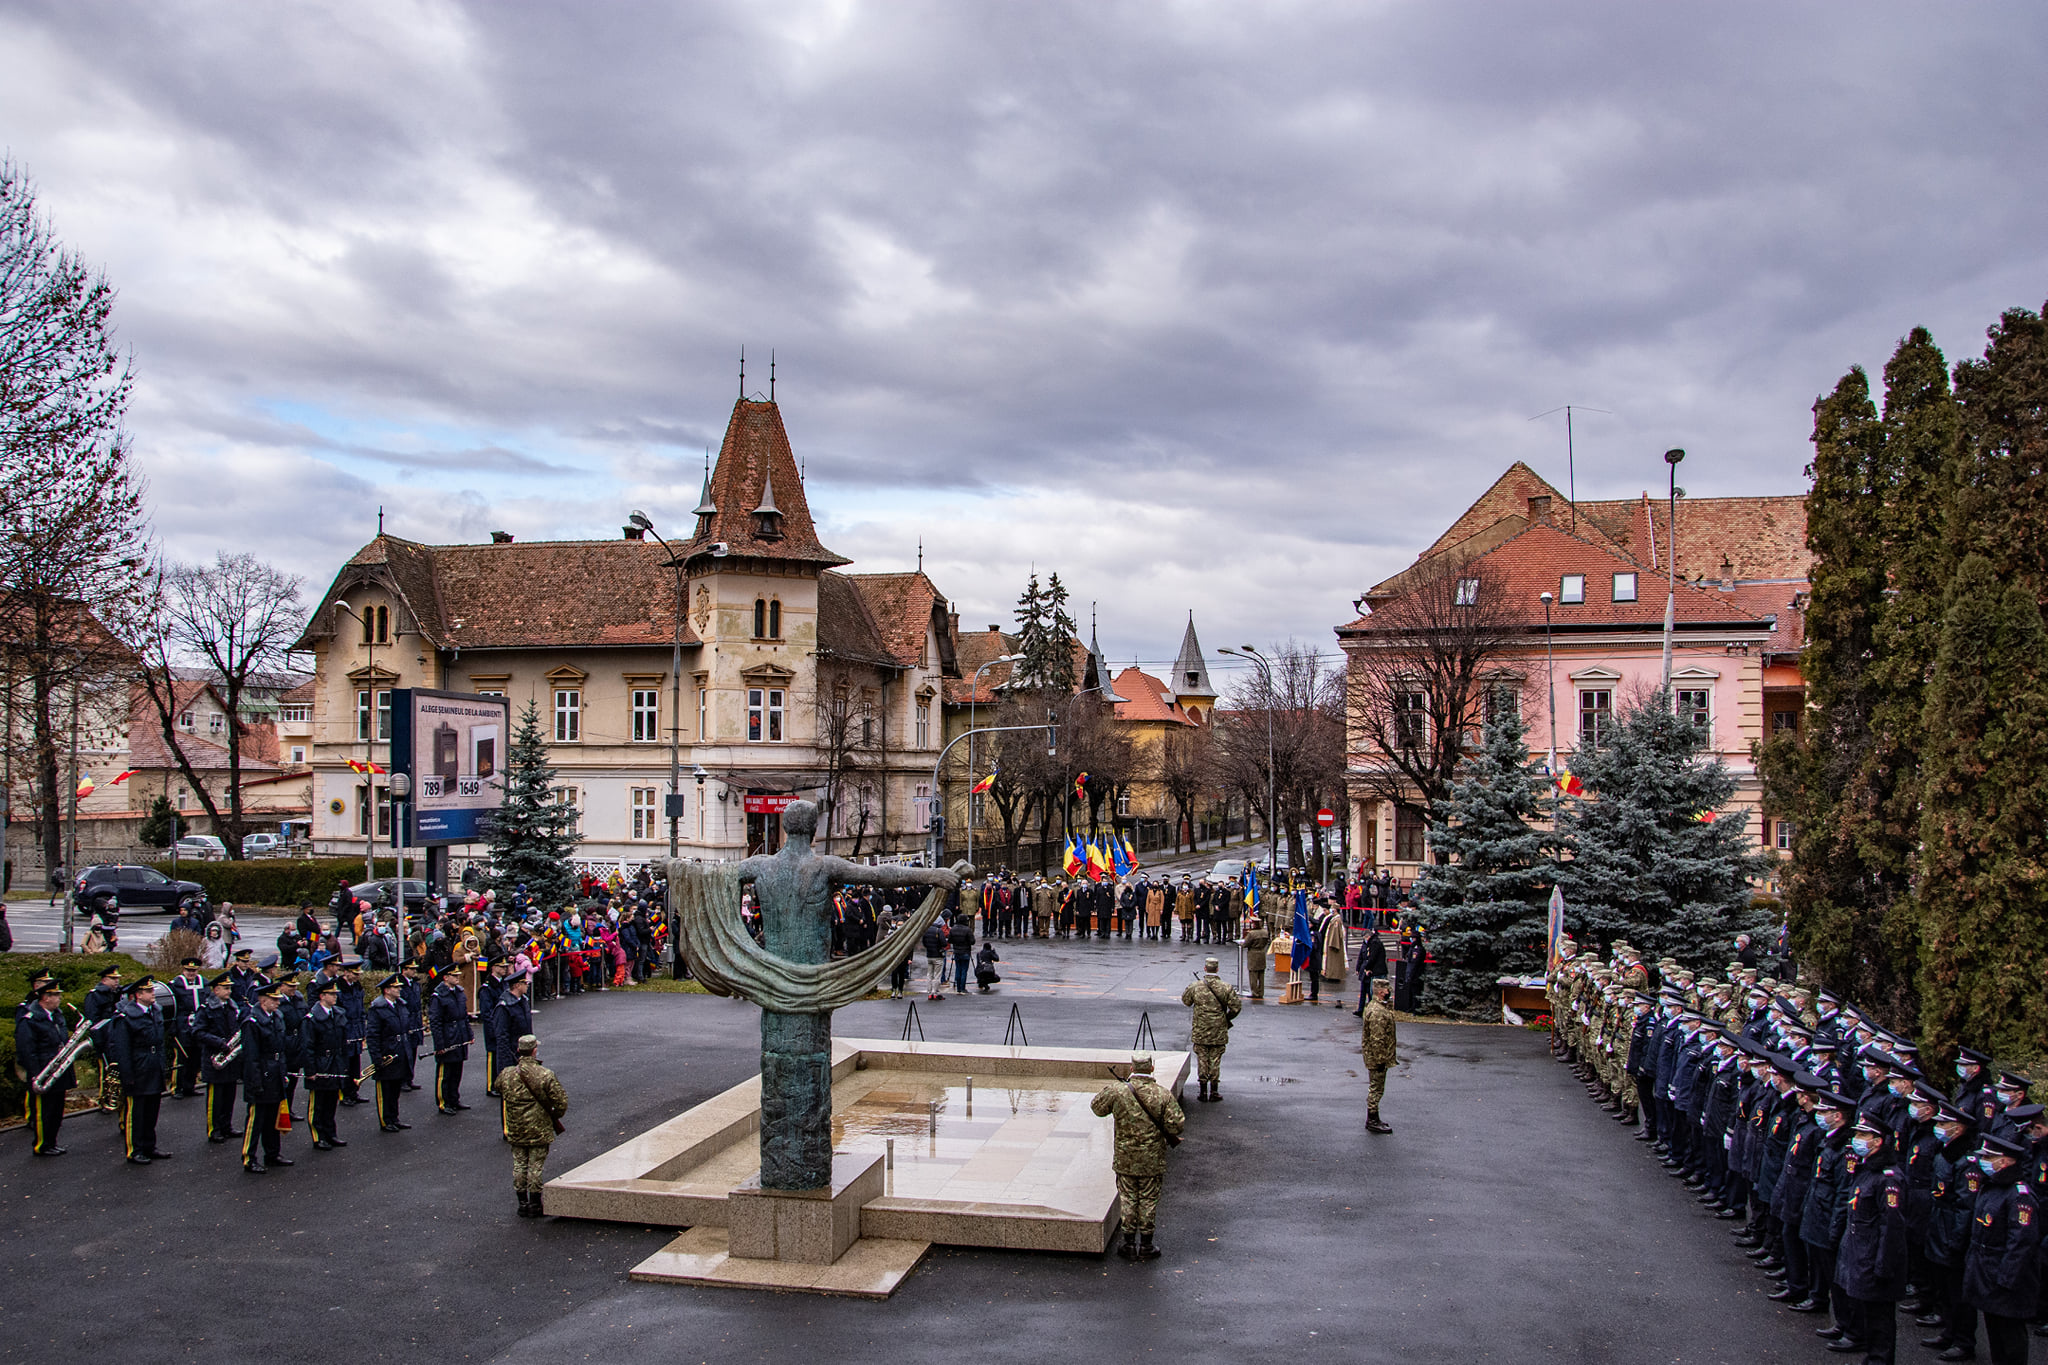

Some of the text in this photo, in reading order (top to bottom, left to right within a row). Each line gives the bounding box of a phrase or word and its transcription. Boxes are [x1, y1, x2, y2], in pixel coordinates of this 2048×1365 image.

[421, 705, 438, 714] ALEGE
[464, 708, 471, 716] DE
[424, 781, 440, 796] 789
[460, 781, 480, 795] 1649
